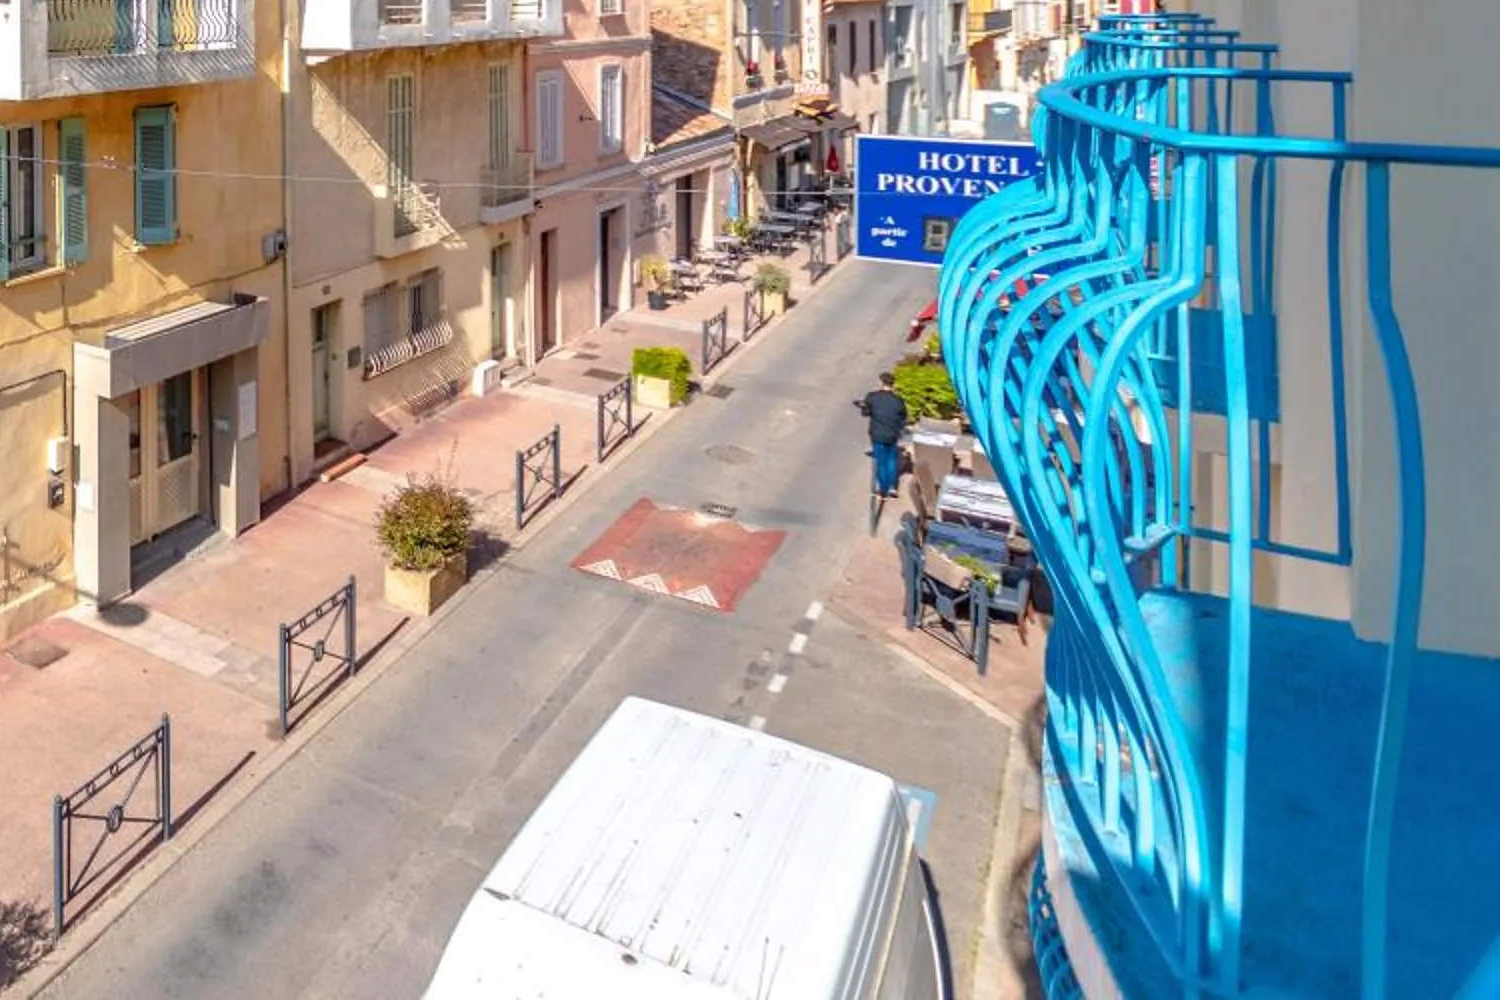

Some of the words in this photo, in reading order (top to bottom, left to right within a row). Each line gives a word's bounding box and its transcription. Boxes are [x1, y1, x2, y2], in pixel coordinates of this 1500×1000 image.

[918, 151, 1029, 177] HOTEL
[876, 173, 1006, 198] PROVEN
[871, 227, 909, 238] partir
[880, 237, 898, 248] de
